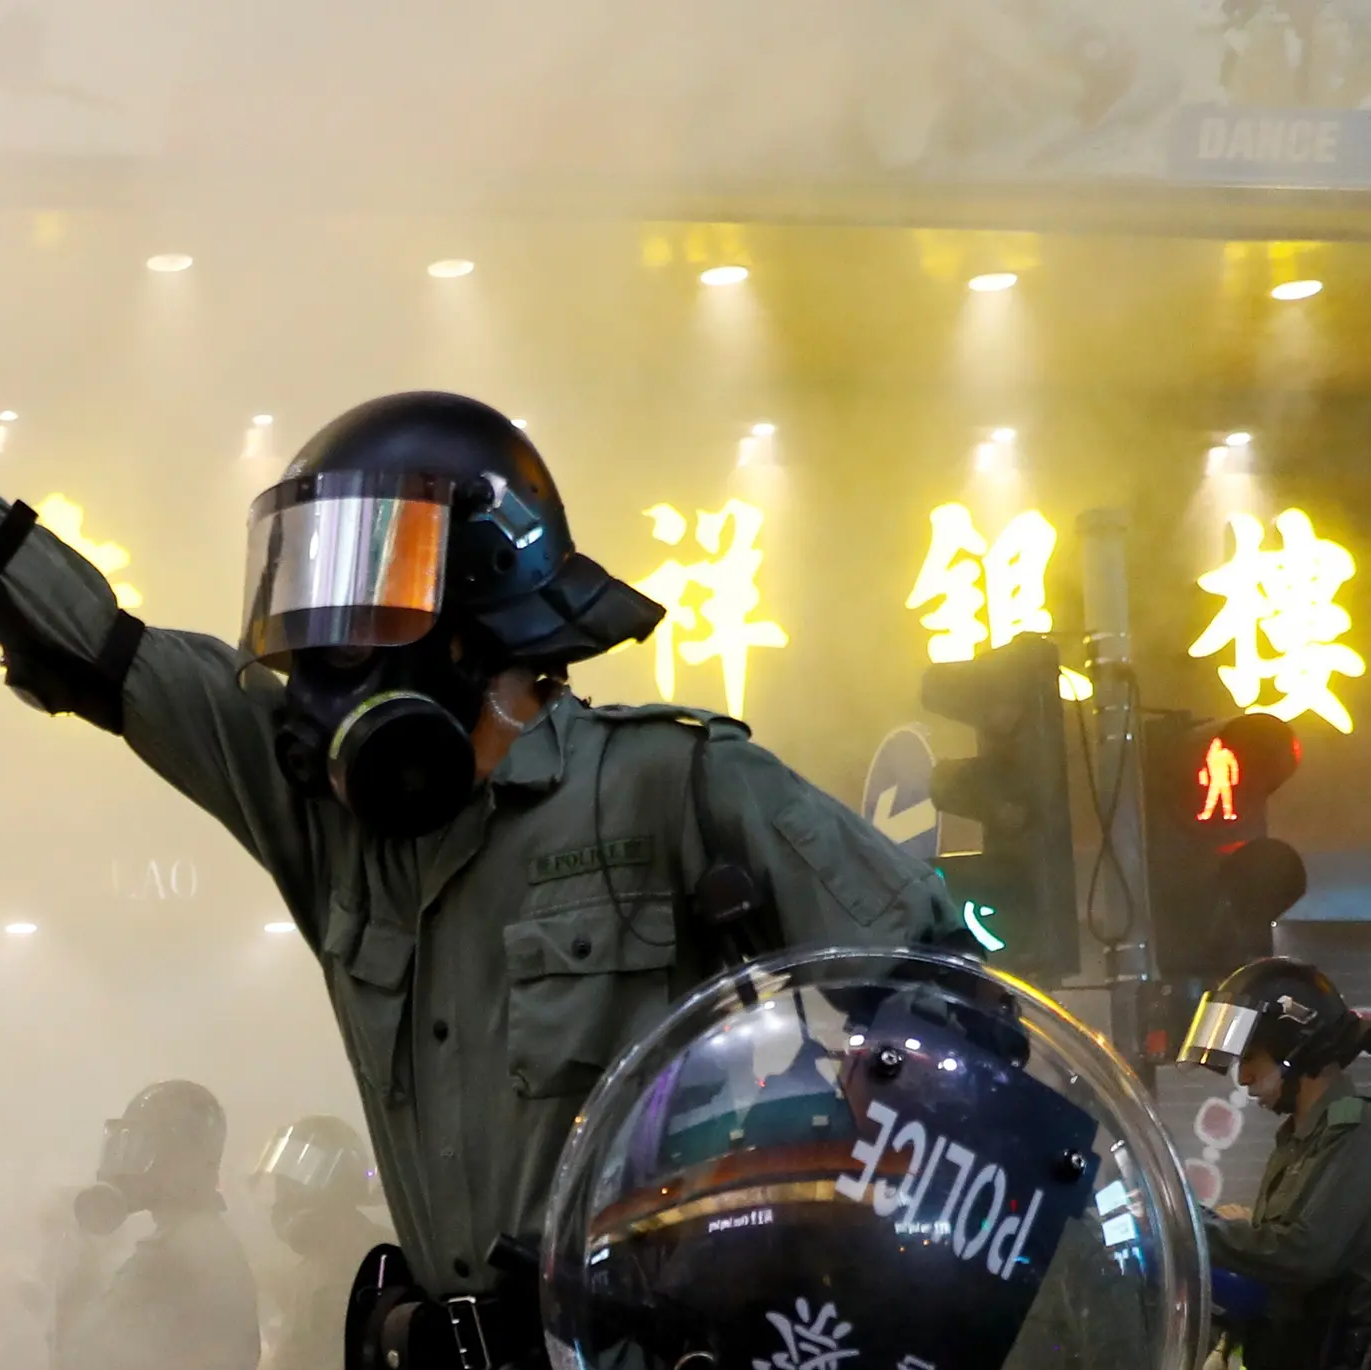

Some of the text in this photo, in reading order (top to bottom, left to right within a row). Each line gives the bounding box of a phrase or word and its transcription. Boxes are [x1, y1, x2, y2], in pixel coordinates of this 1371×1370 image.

[1197, 117, 1341, 163] DANCE
[110, 856, 200, 901] LAO
[834, 1100, 1045, 1282] POLICE
